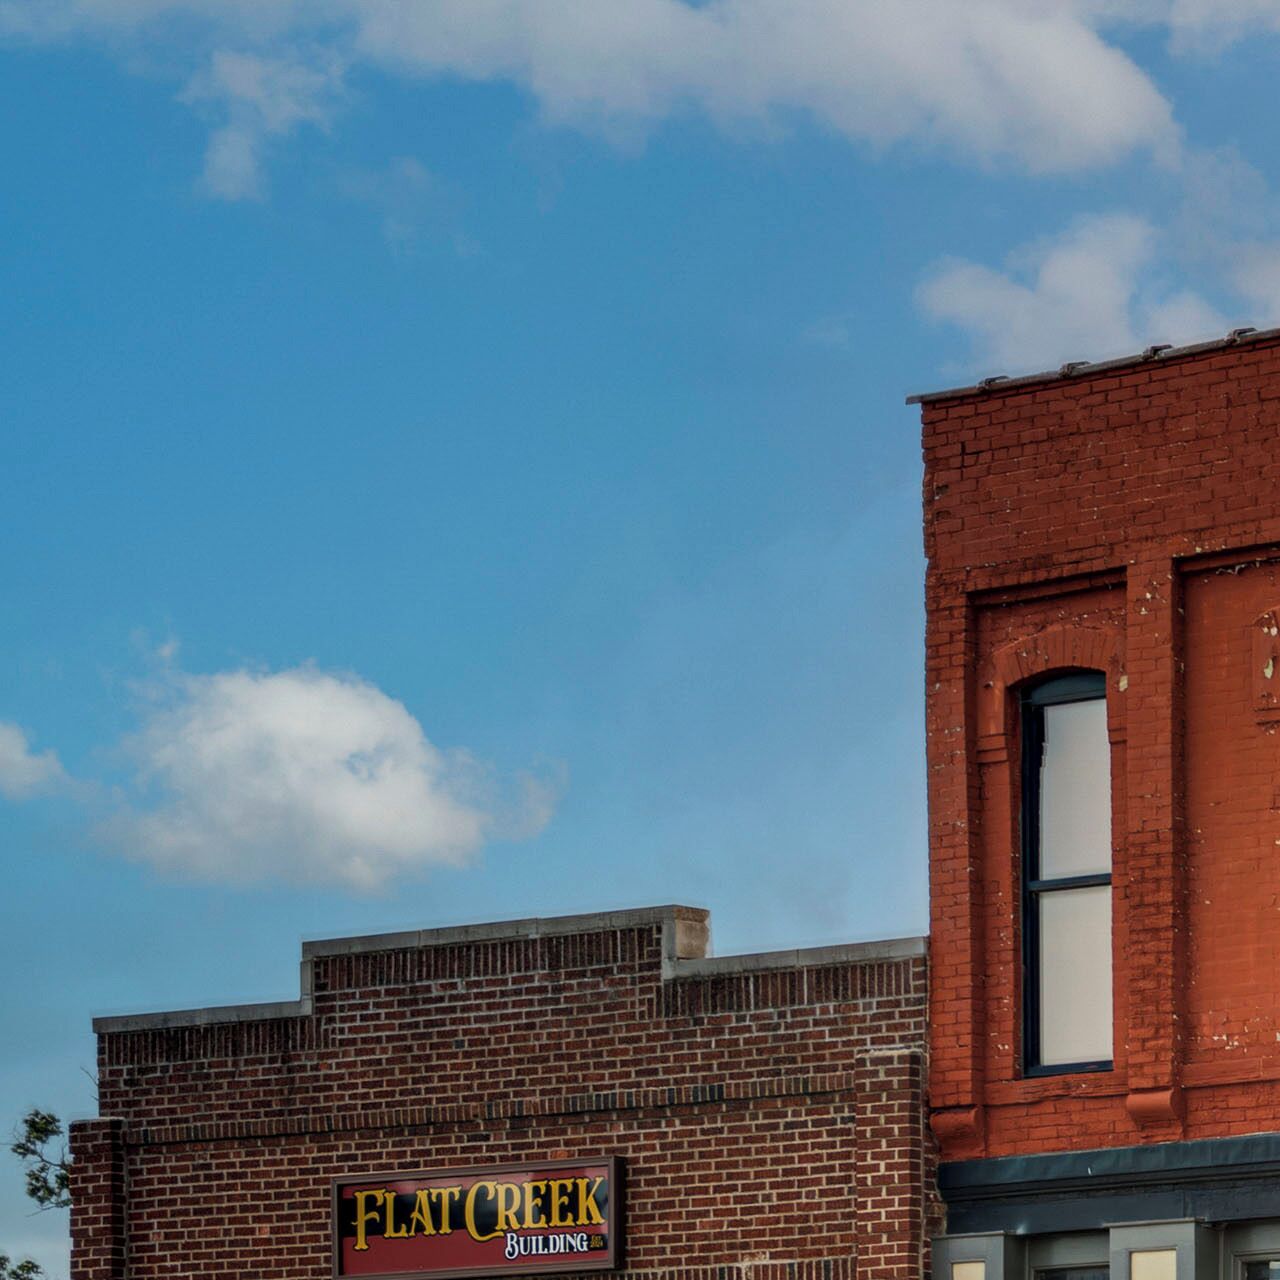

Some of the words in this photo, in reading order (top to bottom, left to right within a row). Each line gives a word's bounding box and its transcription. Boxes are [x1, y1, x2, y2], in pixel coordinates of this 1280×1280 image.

[352, 1187, 462, 1249] FLAT
[464, 1177, 606, 1242] CREEK
[504, 1232, 588, 1260] BUILDING
